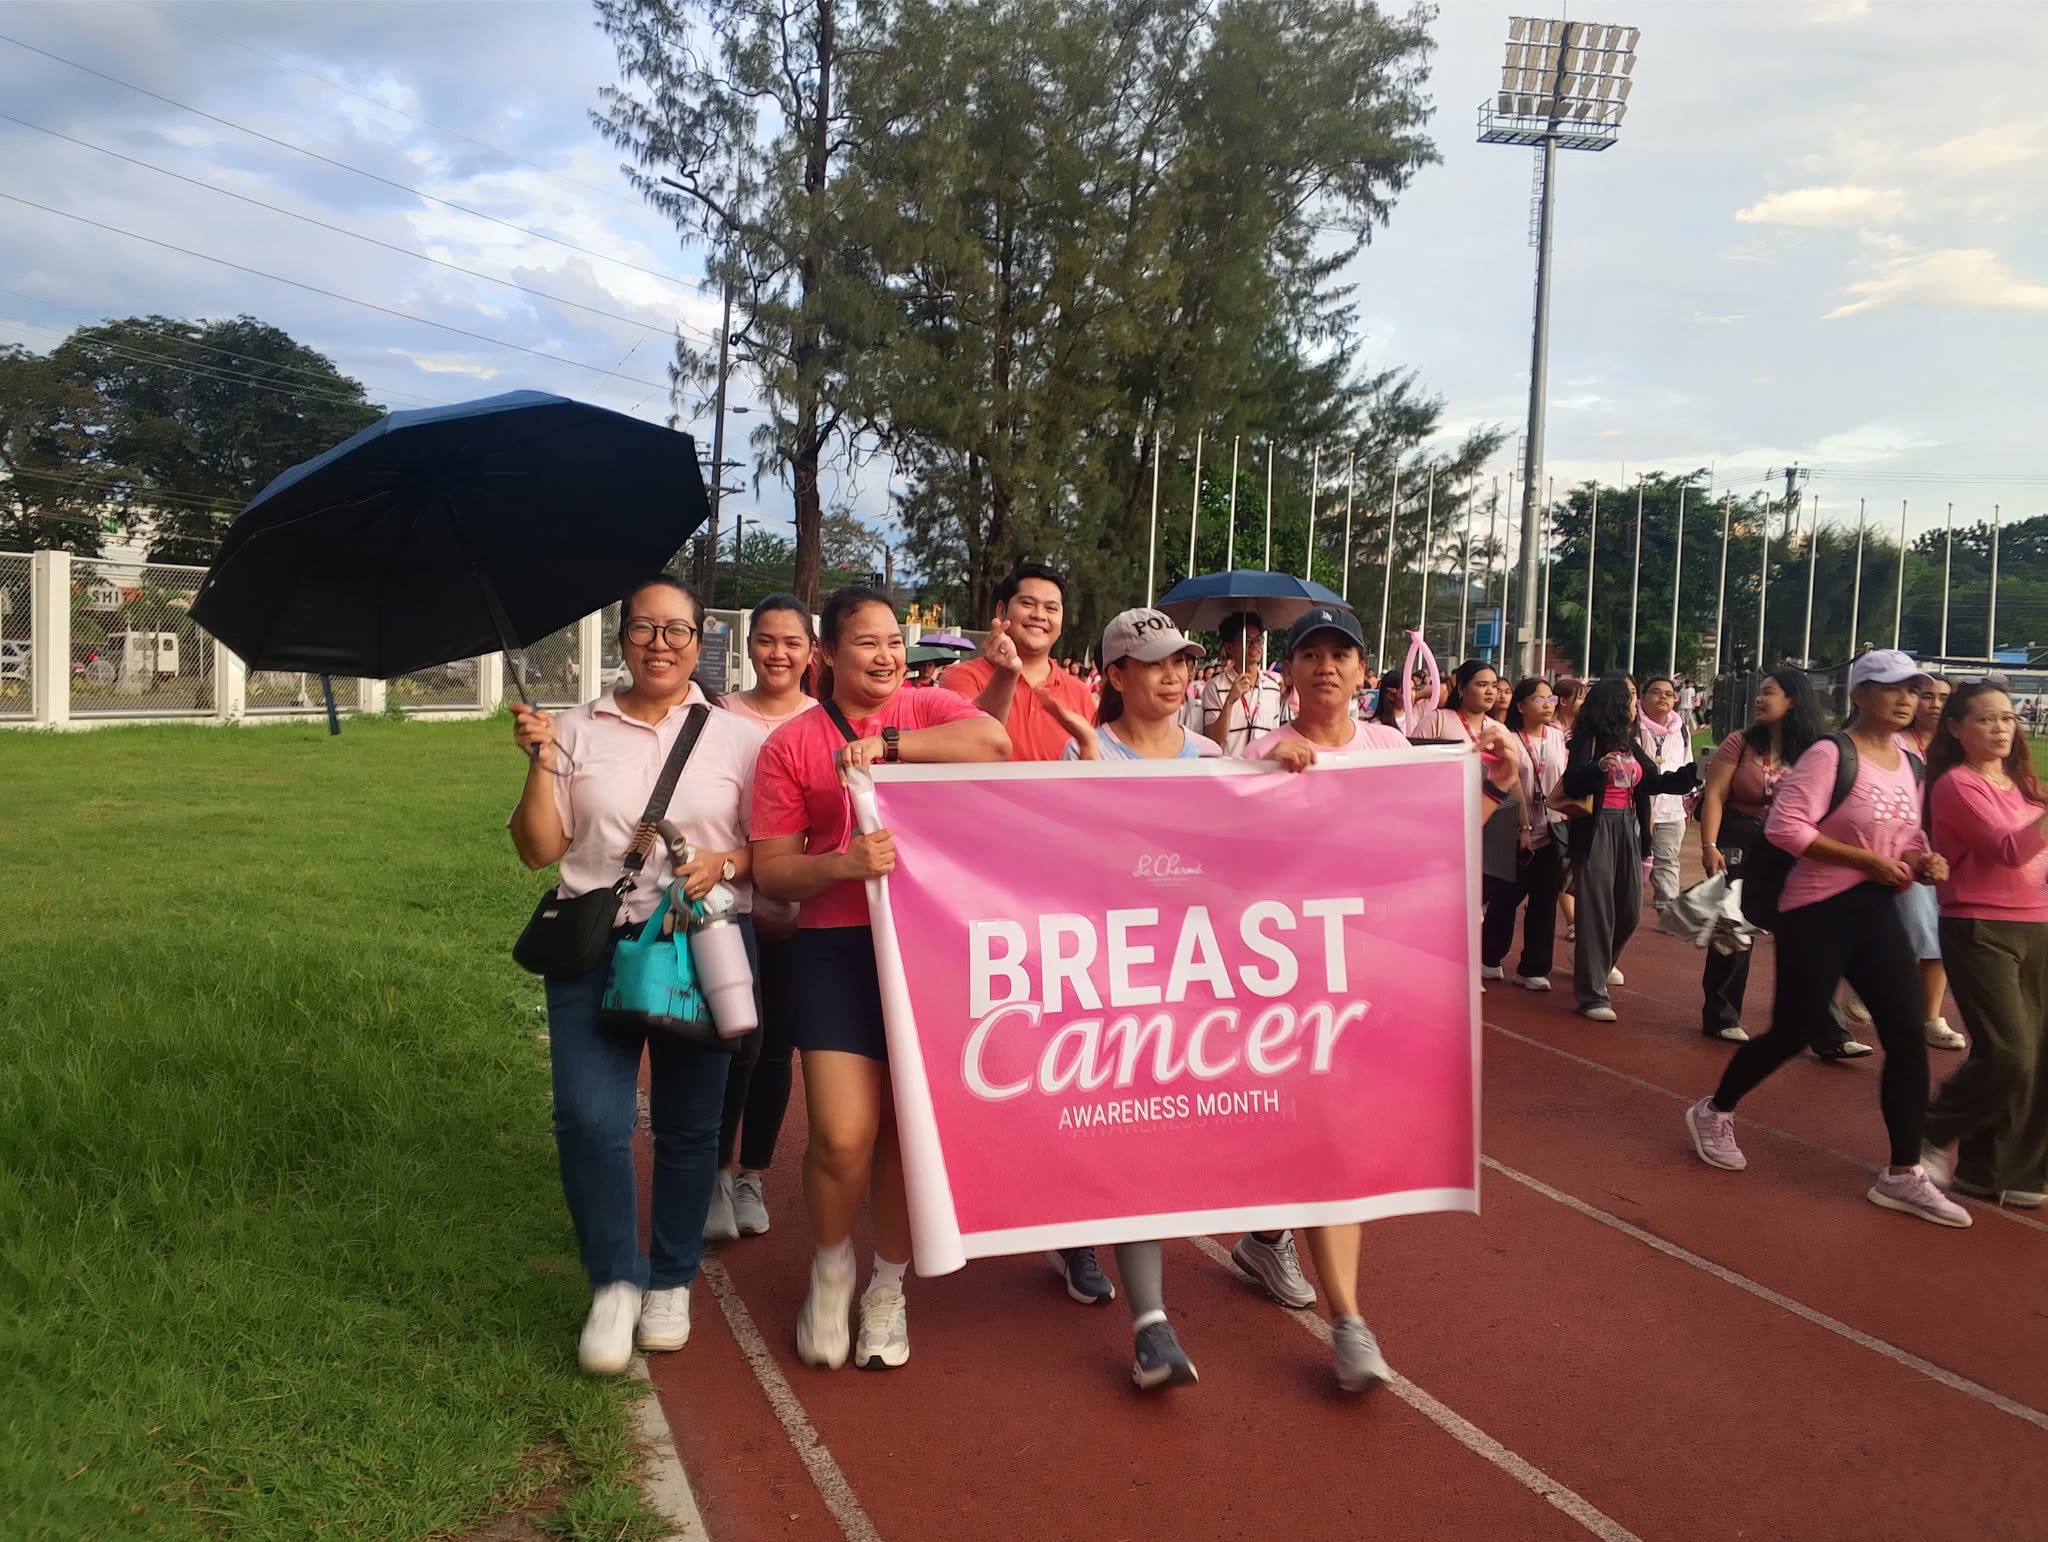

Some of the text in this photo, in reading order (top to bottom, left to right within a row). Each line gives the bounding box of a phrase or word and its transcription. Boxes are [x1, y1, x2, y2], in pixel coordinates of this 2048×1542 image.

[969, 897, 1365, 1019] BREAST
[961, 1000, 1371, 1101] Cancer
[1058, 1089, 1280, 1130] AWARENESS MONTH
